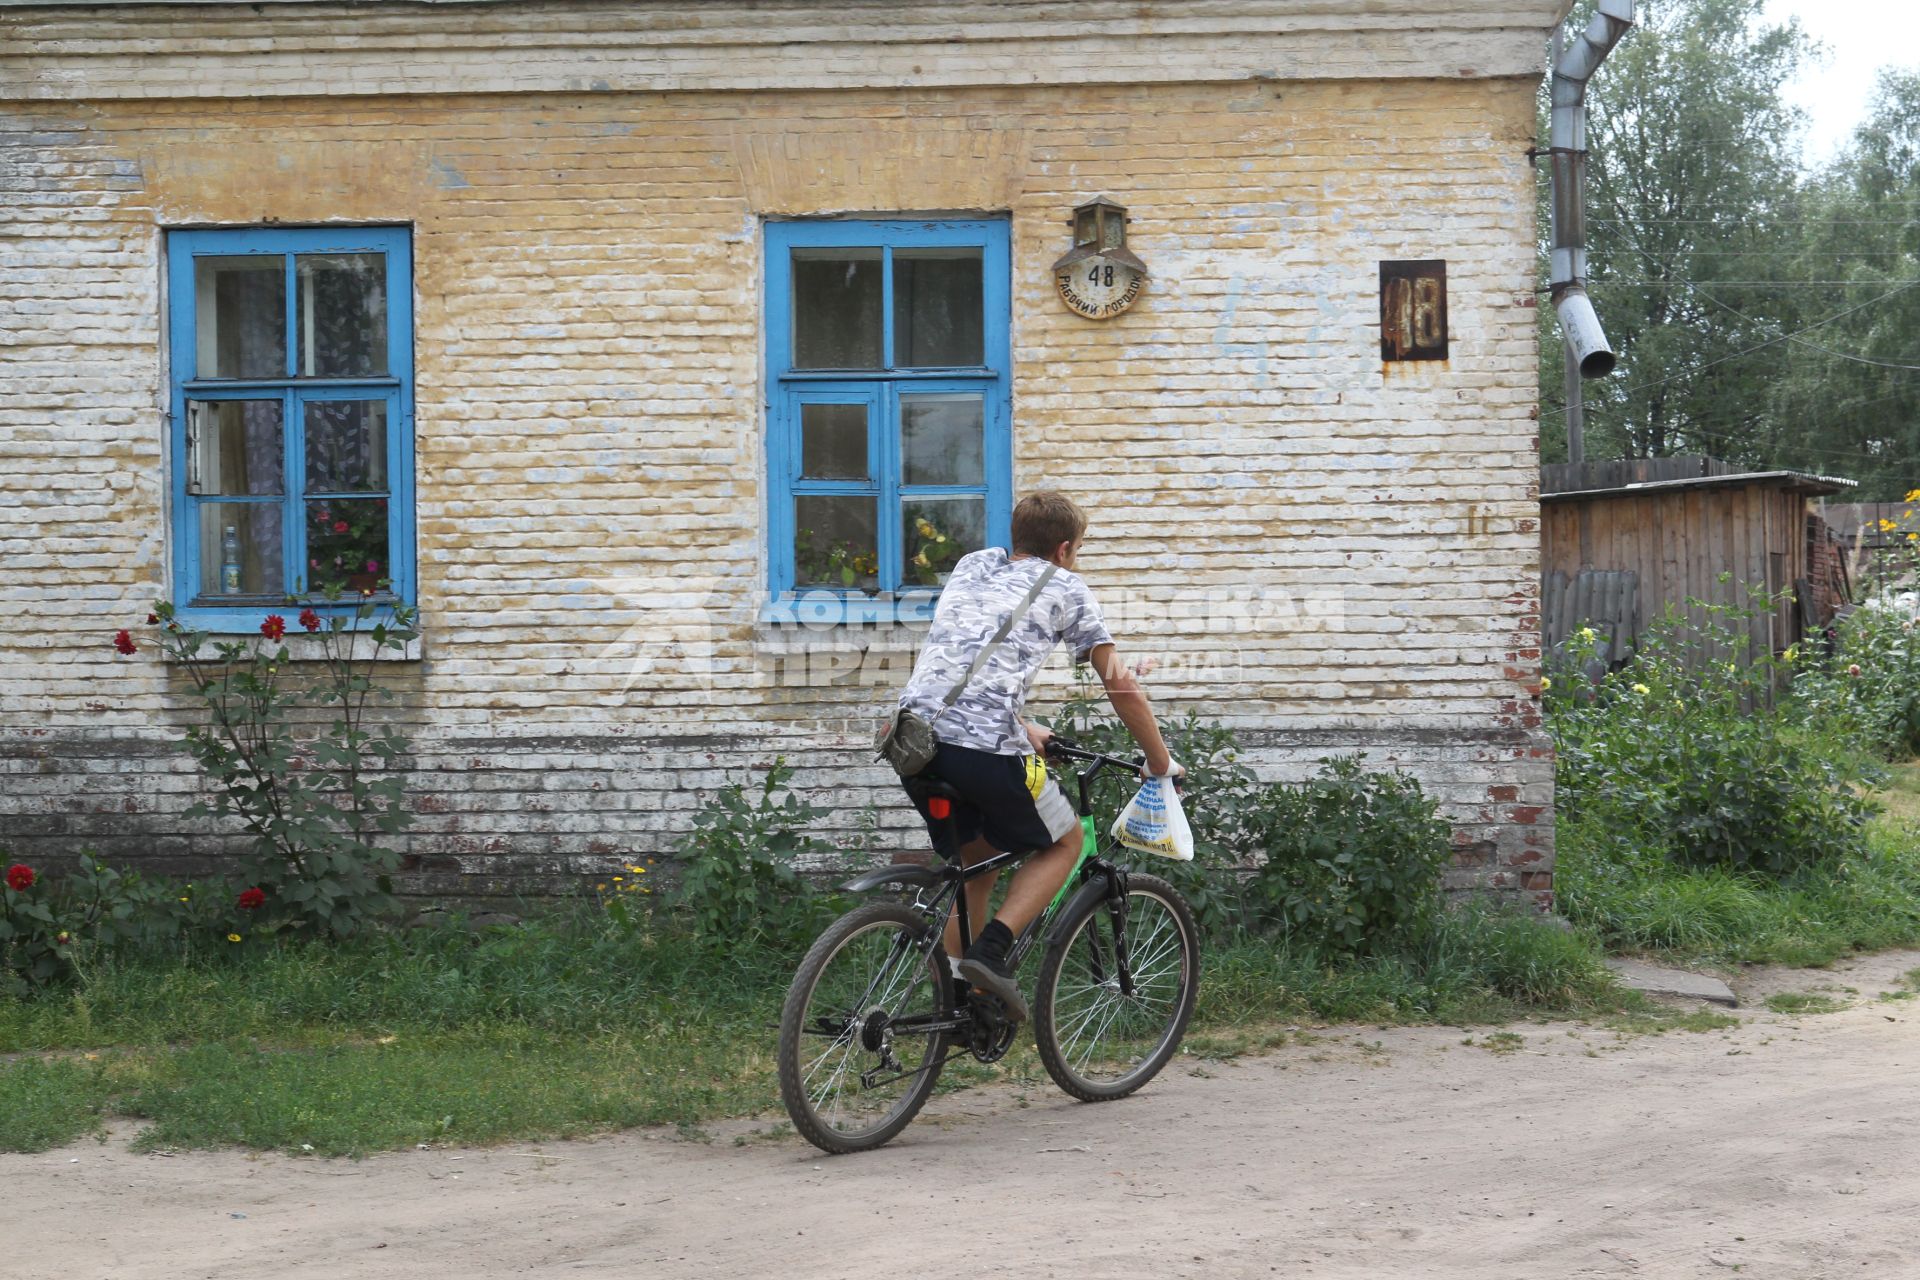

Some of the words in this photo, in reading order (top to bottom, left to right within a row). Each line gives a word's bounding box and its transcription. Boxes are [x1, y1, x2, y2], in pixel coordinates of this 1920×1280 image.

[1088, 265, 1113, 287] 48
[1059, 275, 1097, 315] РАБОЧИЙ
[1104, 275, 1141, 314] ГОРОДОК
